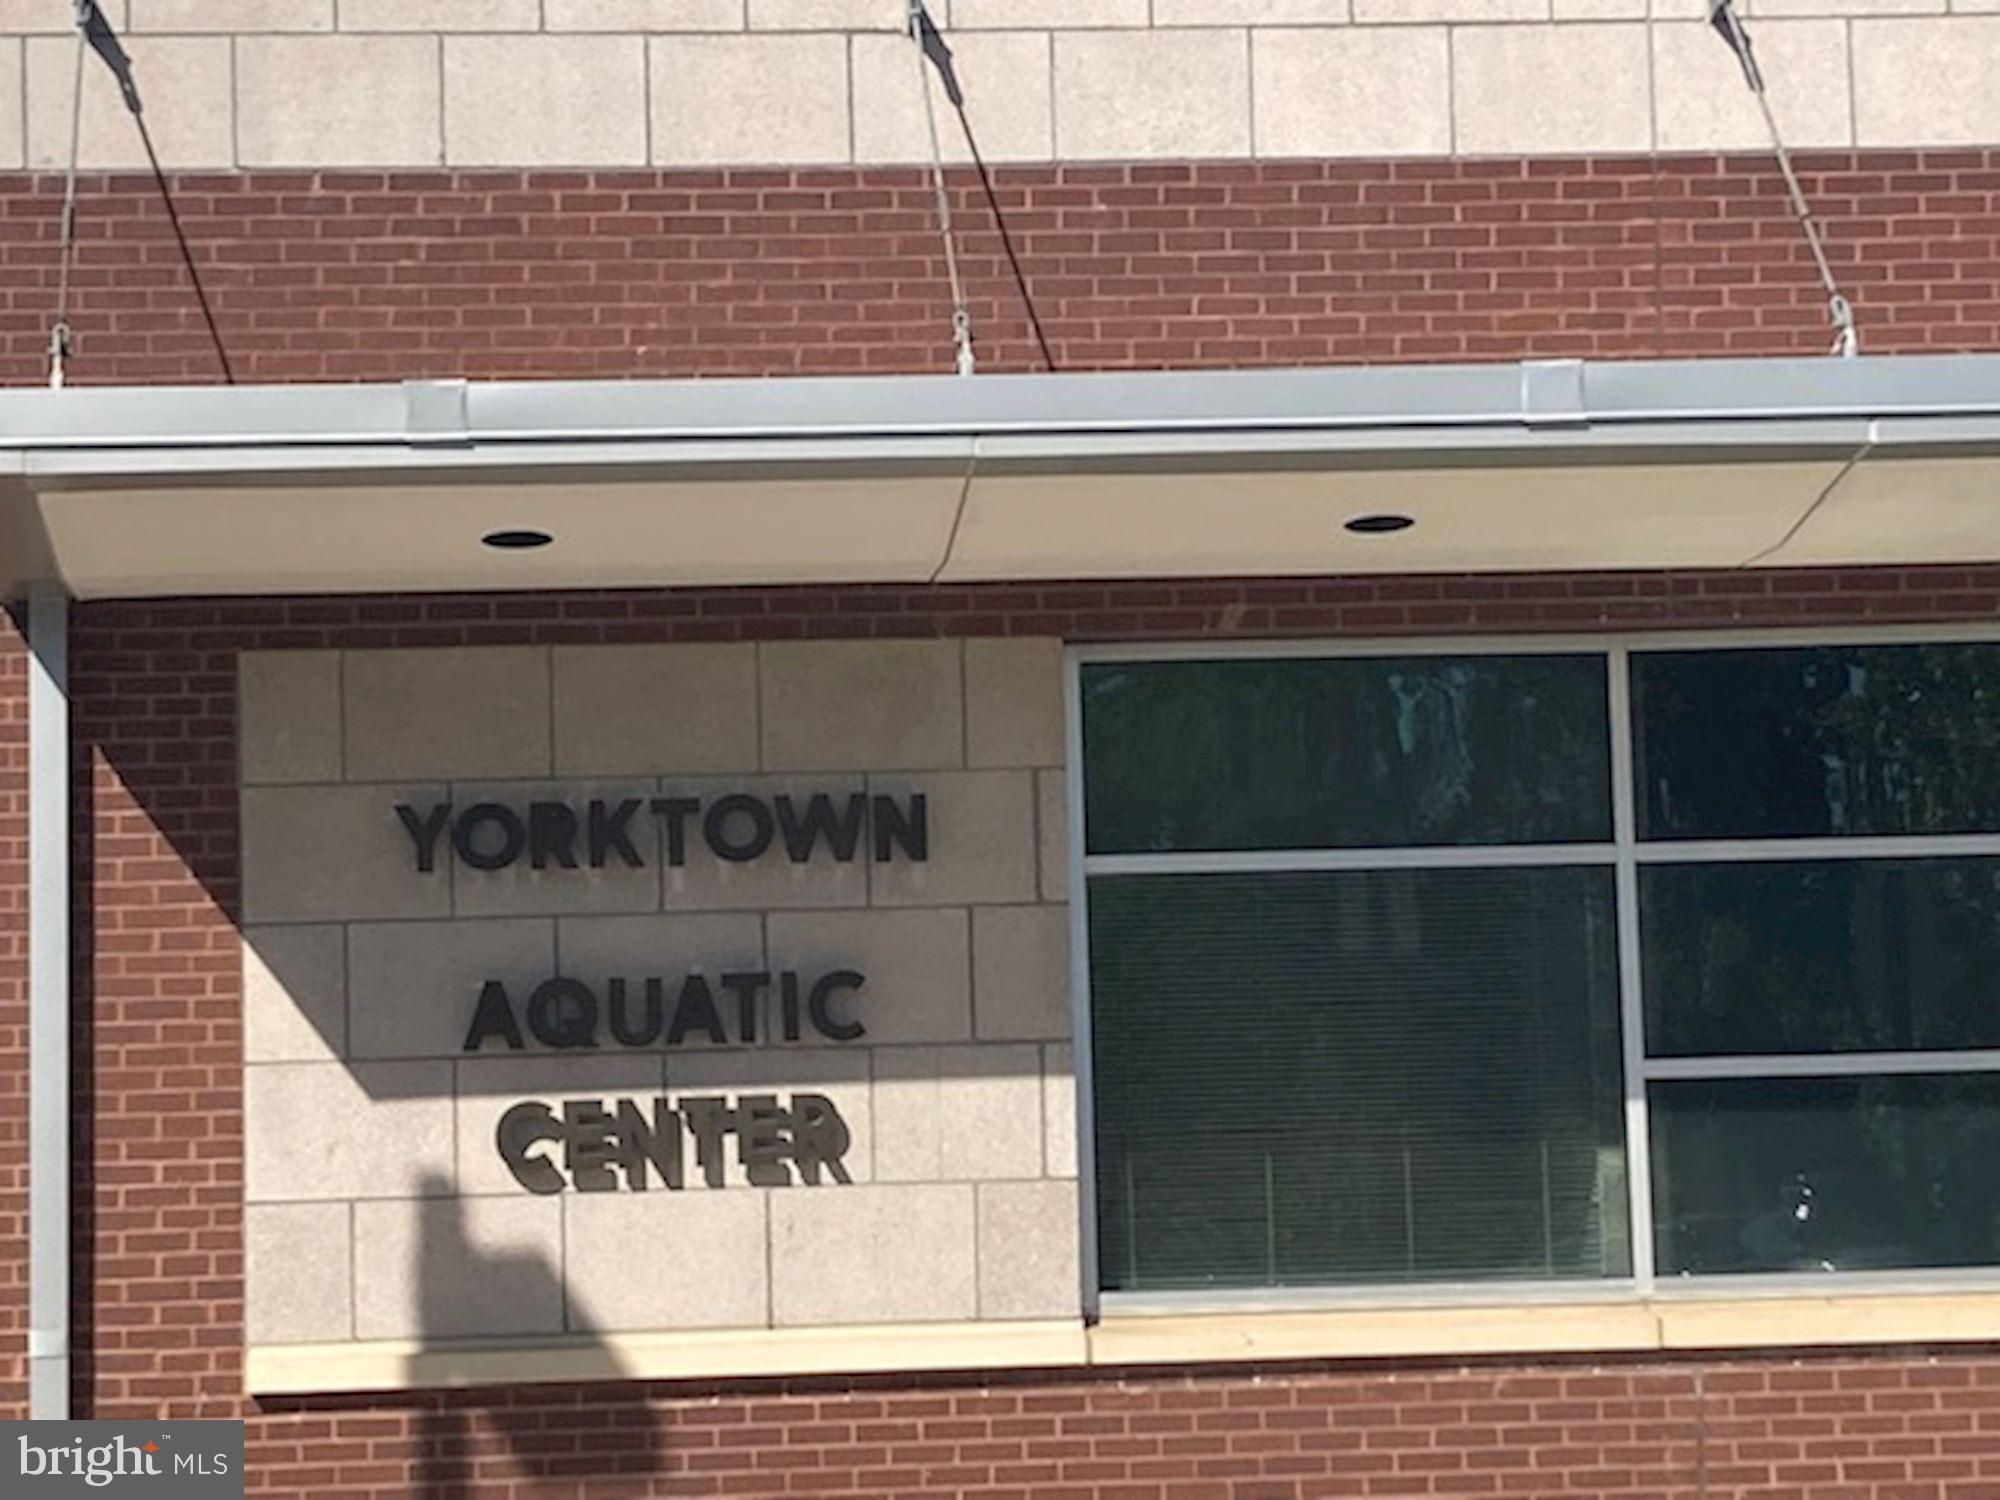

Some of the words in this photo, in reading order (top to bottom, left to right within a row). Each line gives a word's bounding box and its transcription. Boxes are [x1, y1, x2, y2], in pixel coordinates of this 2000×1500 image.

[394, 793, 929, 873] YORKTOWN
[462, 969, 867, 1052] AQUATIC
[495, 1093, 850, 1190] CENTER
